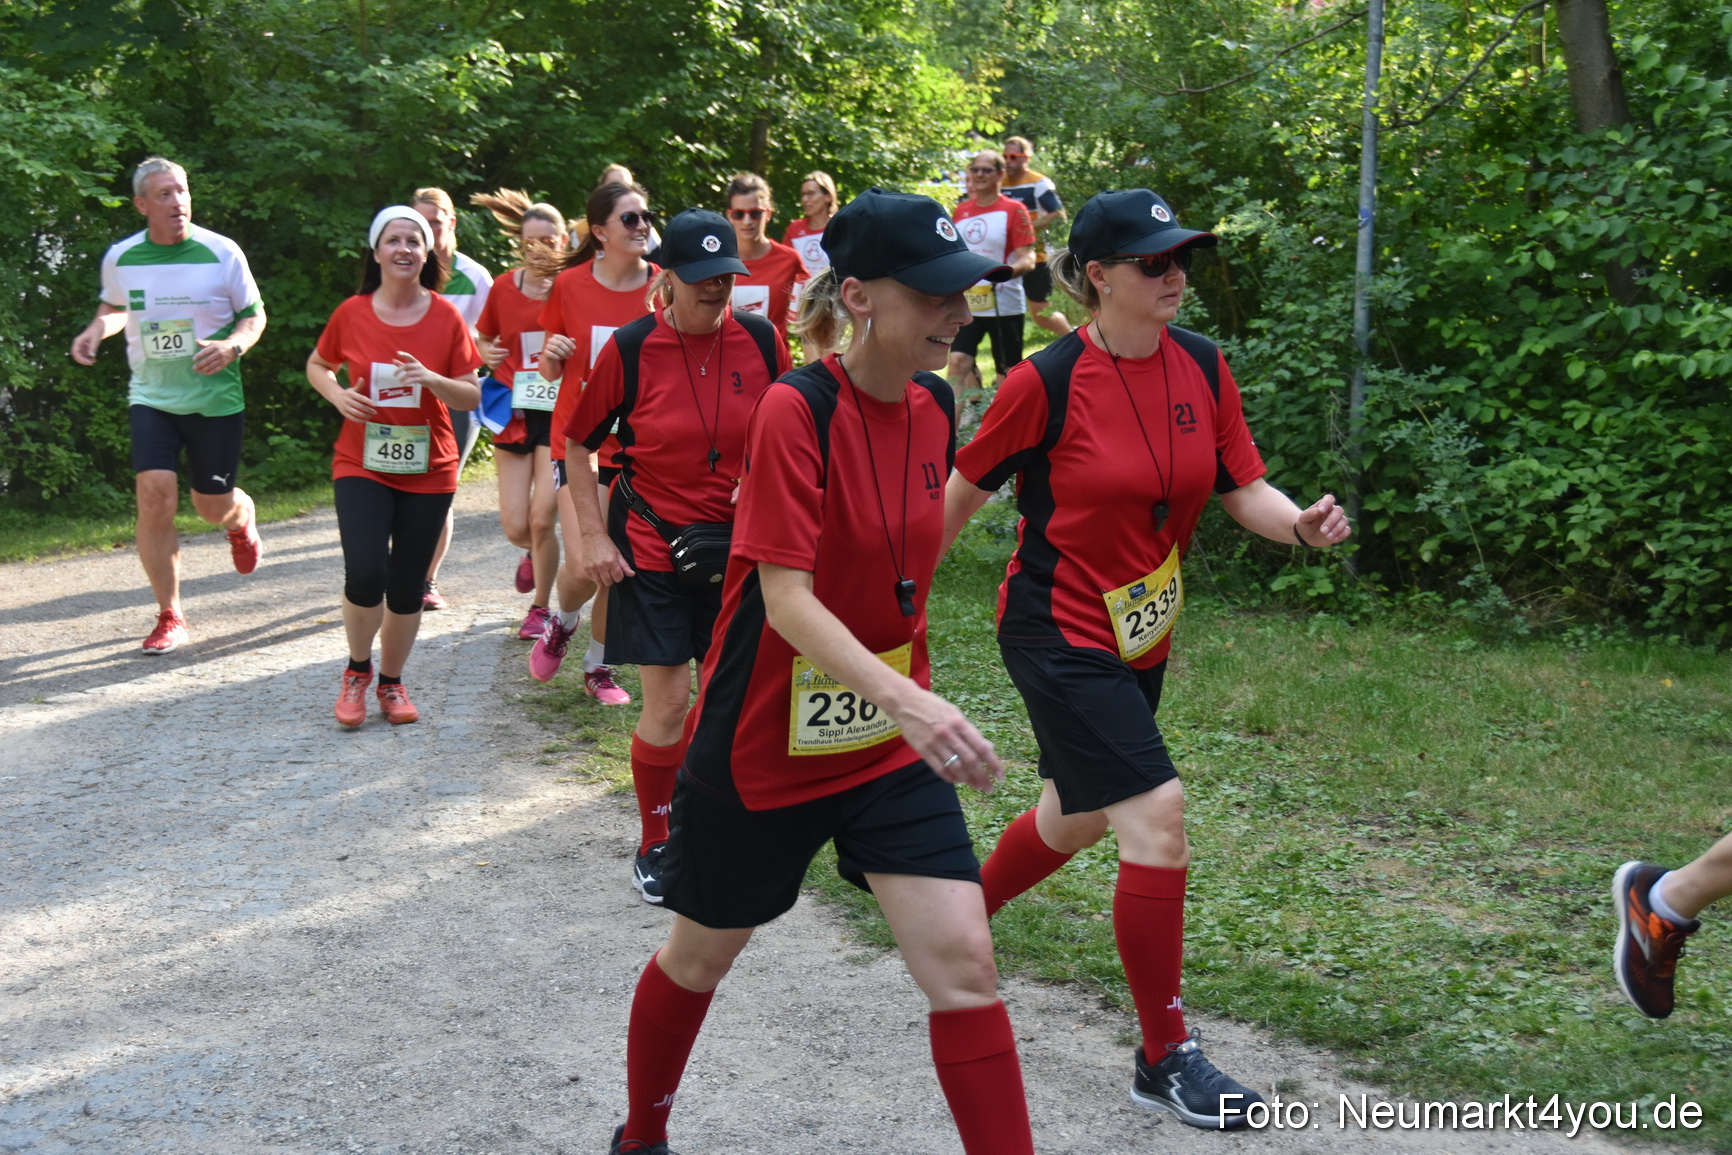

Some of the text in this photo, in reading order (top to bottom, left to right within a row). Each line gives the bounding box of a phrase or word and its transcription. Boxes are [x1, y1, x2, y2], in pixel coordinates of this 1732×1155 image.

[152, 334, 183, 350] 120
[731, 371, 742, 387] 3
[525, 384, 557, 400] 526
[1174, 402, 1197, 426] 21
[377, 442, 415, 460] 488
[921, 462, 940, 490] 11
[1125, 576, 1178, 640] 2339
[806, 691, 889, 727] 236
[797, 738, 833, 746] Trendhaus
[834, 727, 889, 744] Handelsgesellschaft
[818, 719, 887, 739] Sippl Alexandra
